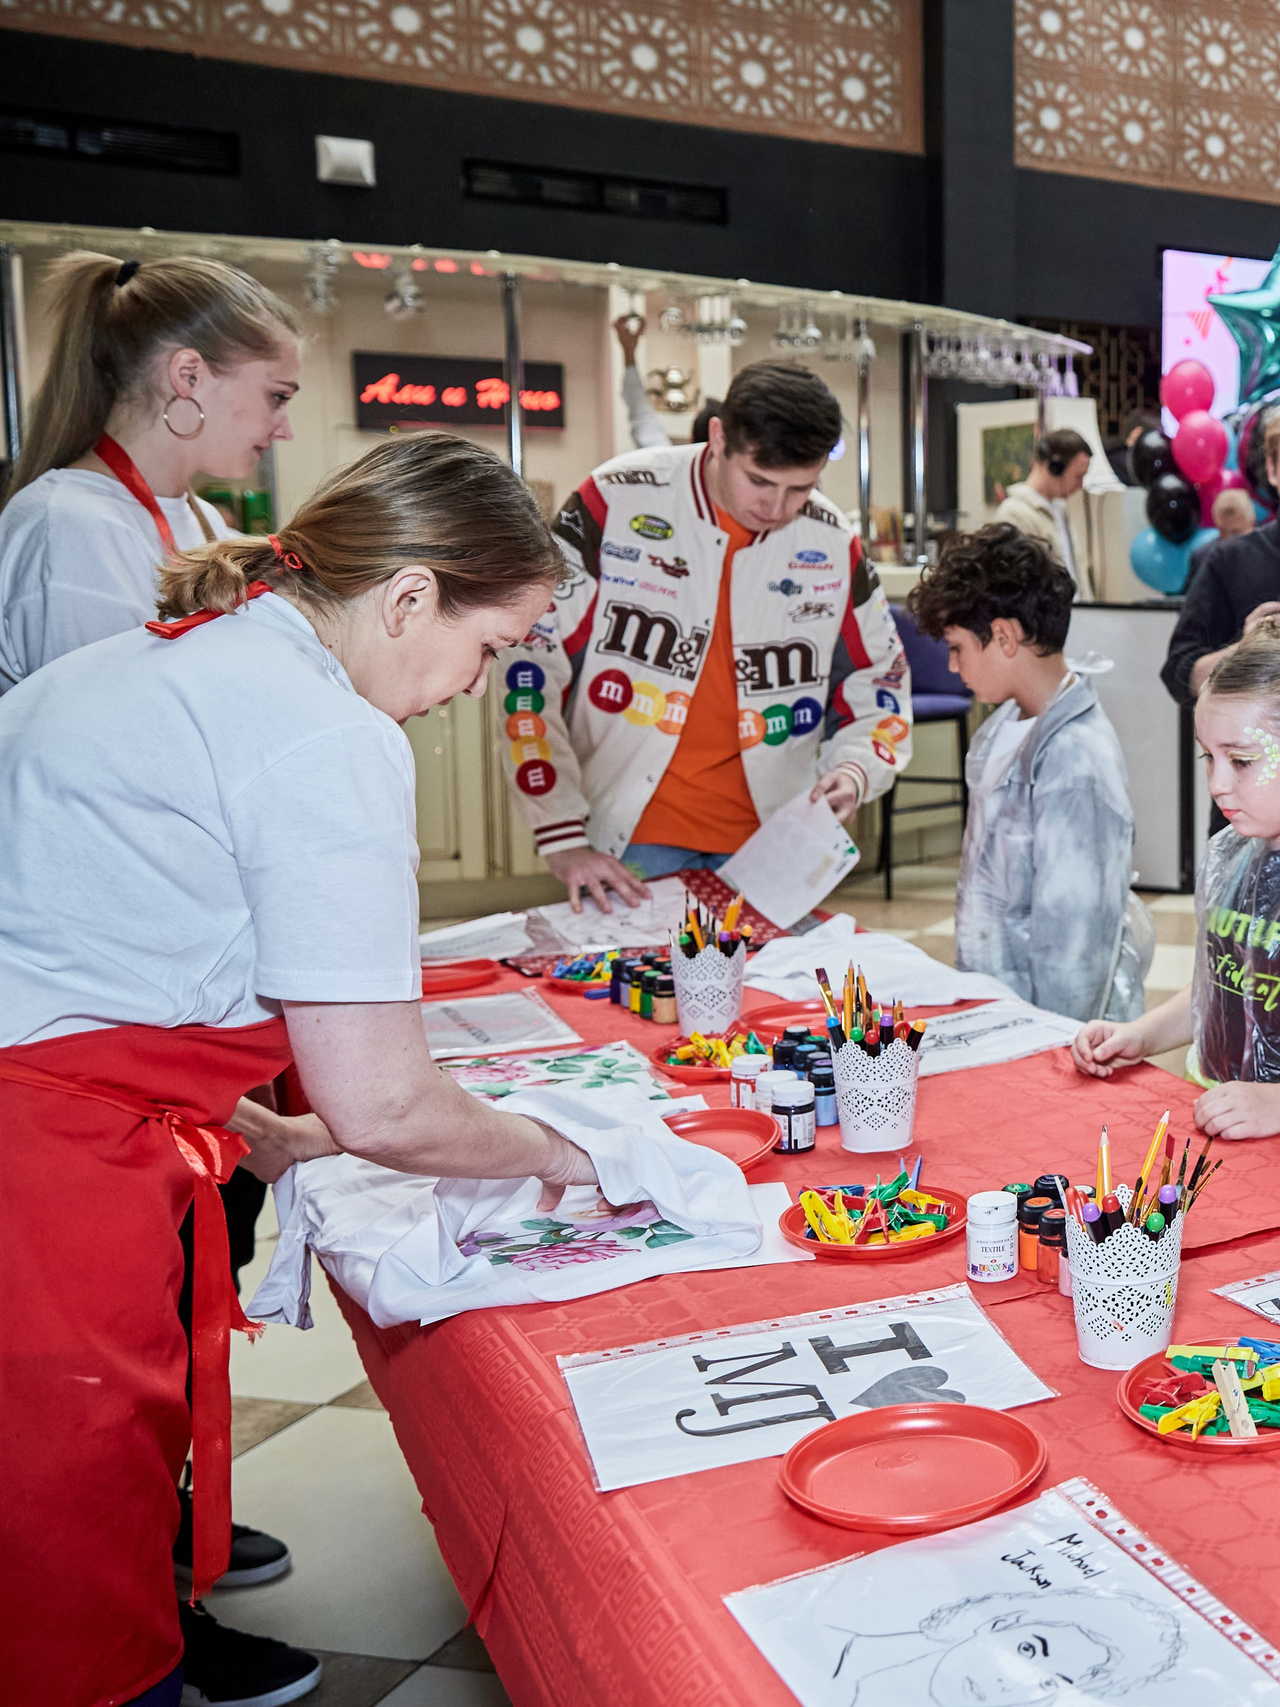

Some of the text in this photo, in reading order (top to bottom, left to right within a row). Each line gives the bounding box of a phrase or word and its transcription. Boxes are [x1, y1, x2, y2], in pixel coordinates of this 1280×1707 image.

[475, 377, 561, 411] Нно
[599, 680, 624, 704] m
[767, 715, 788, 735] m
[981, 1244, 1006, 1253] TEXTILE
